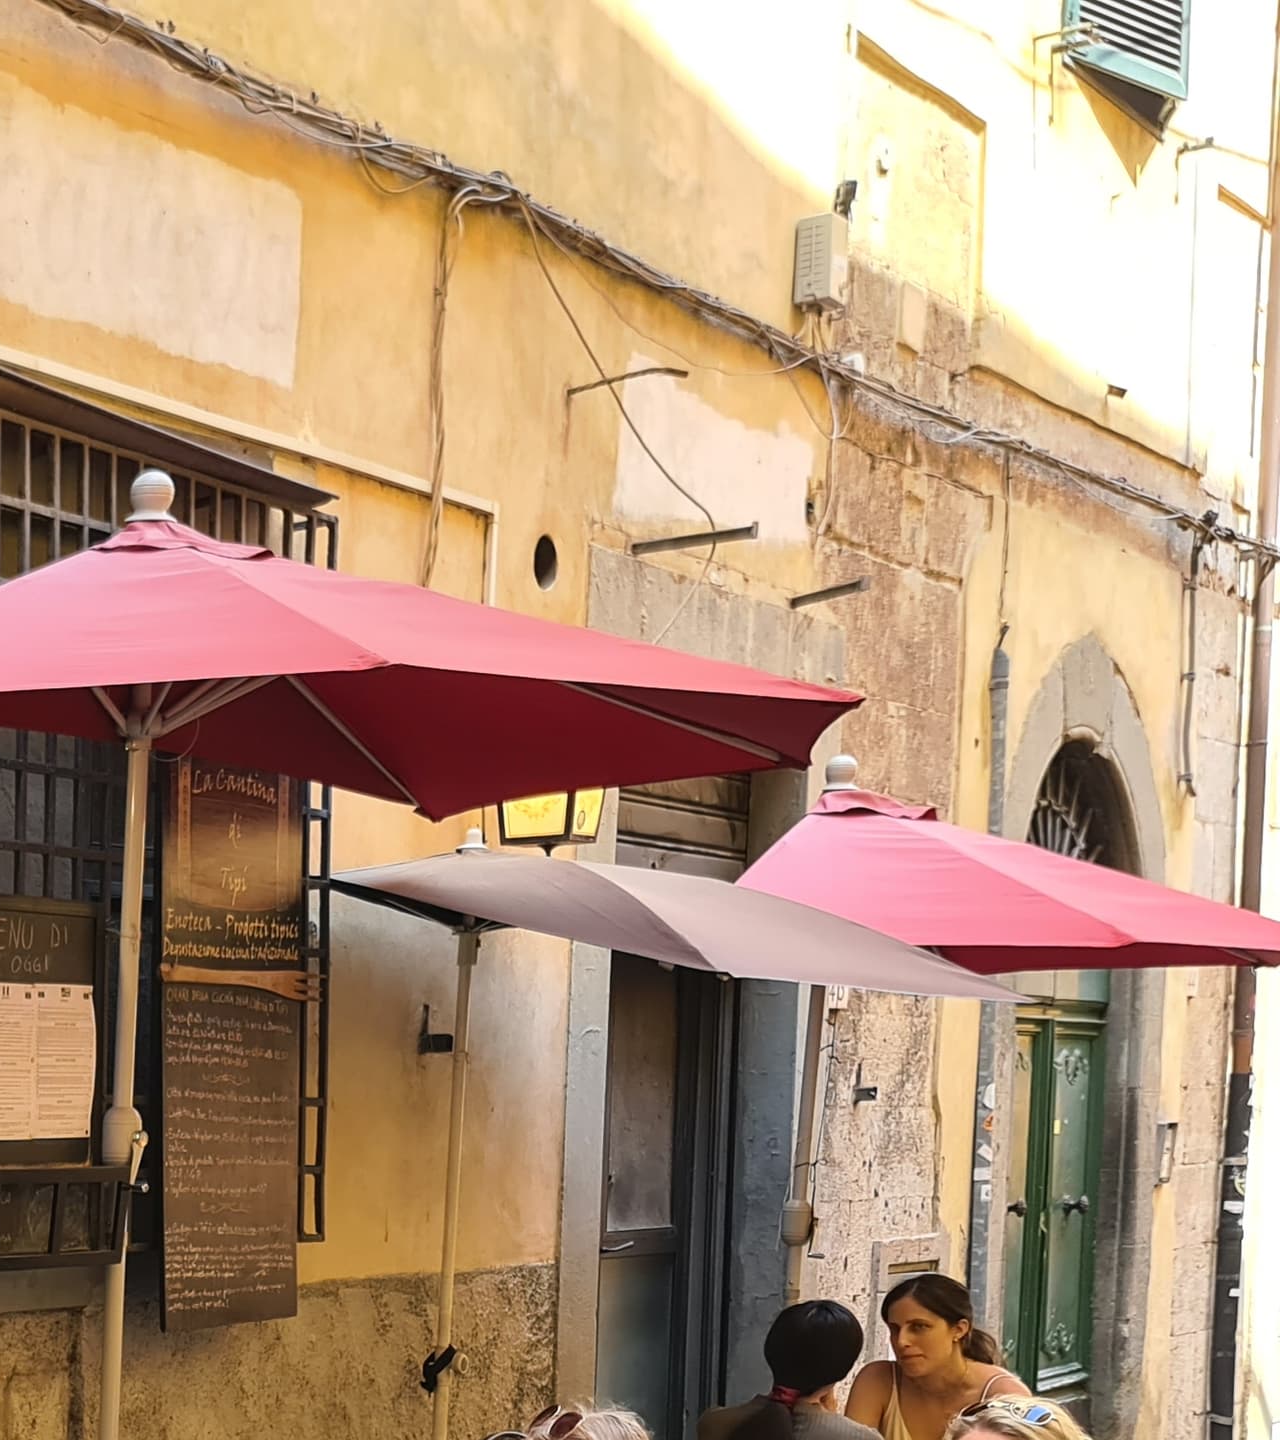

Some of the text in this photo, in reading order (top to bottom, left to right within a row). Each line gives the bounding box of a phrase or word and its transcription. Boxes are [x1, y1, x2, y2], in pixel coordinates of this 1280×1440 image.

[192, 769, 277, 804] La Cantina
[228, 812, 242, 848] di
[50, 923, 68, 948] DI
[165, 908, 298, 946] Enoteca Prodotti tipici
[11, 955, 49, 974] OGGI
